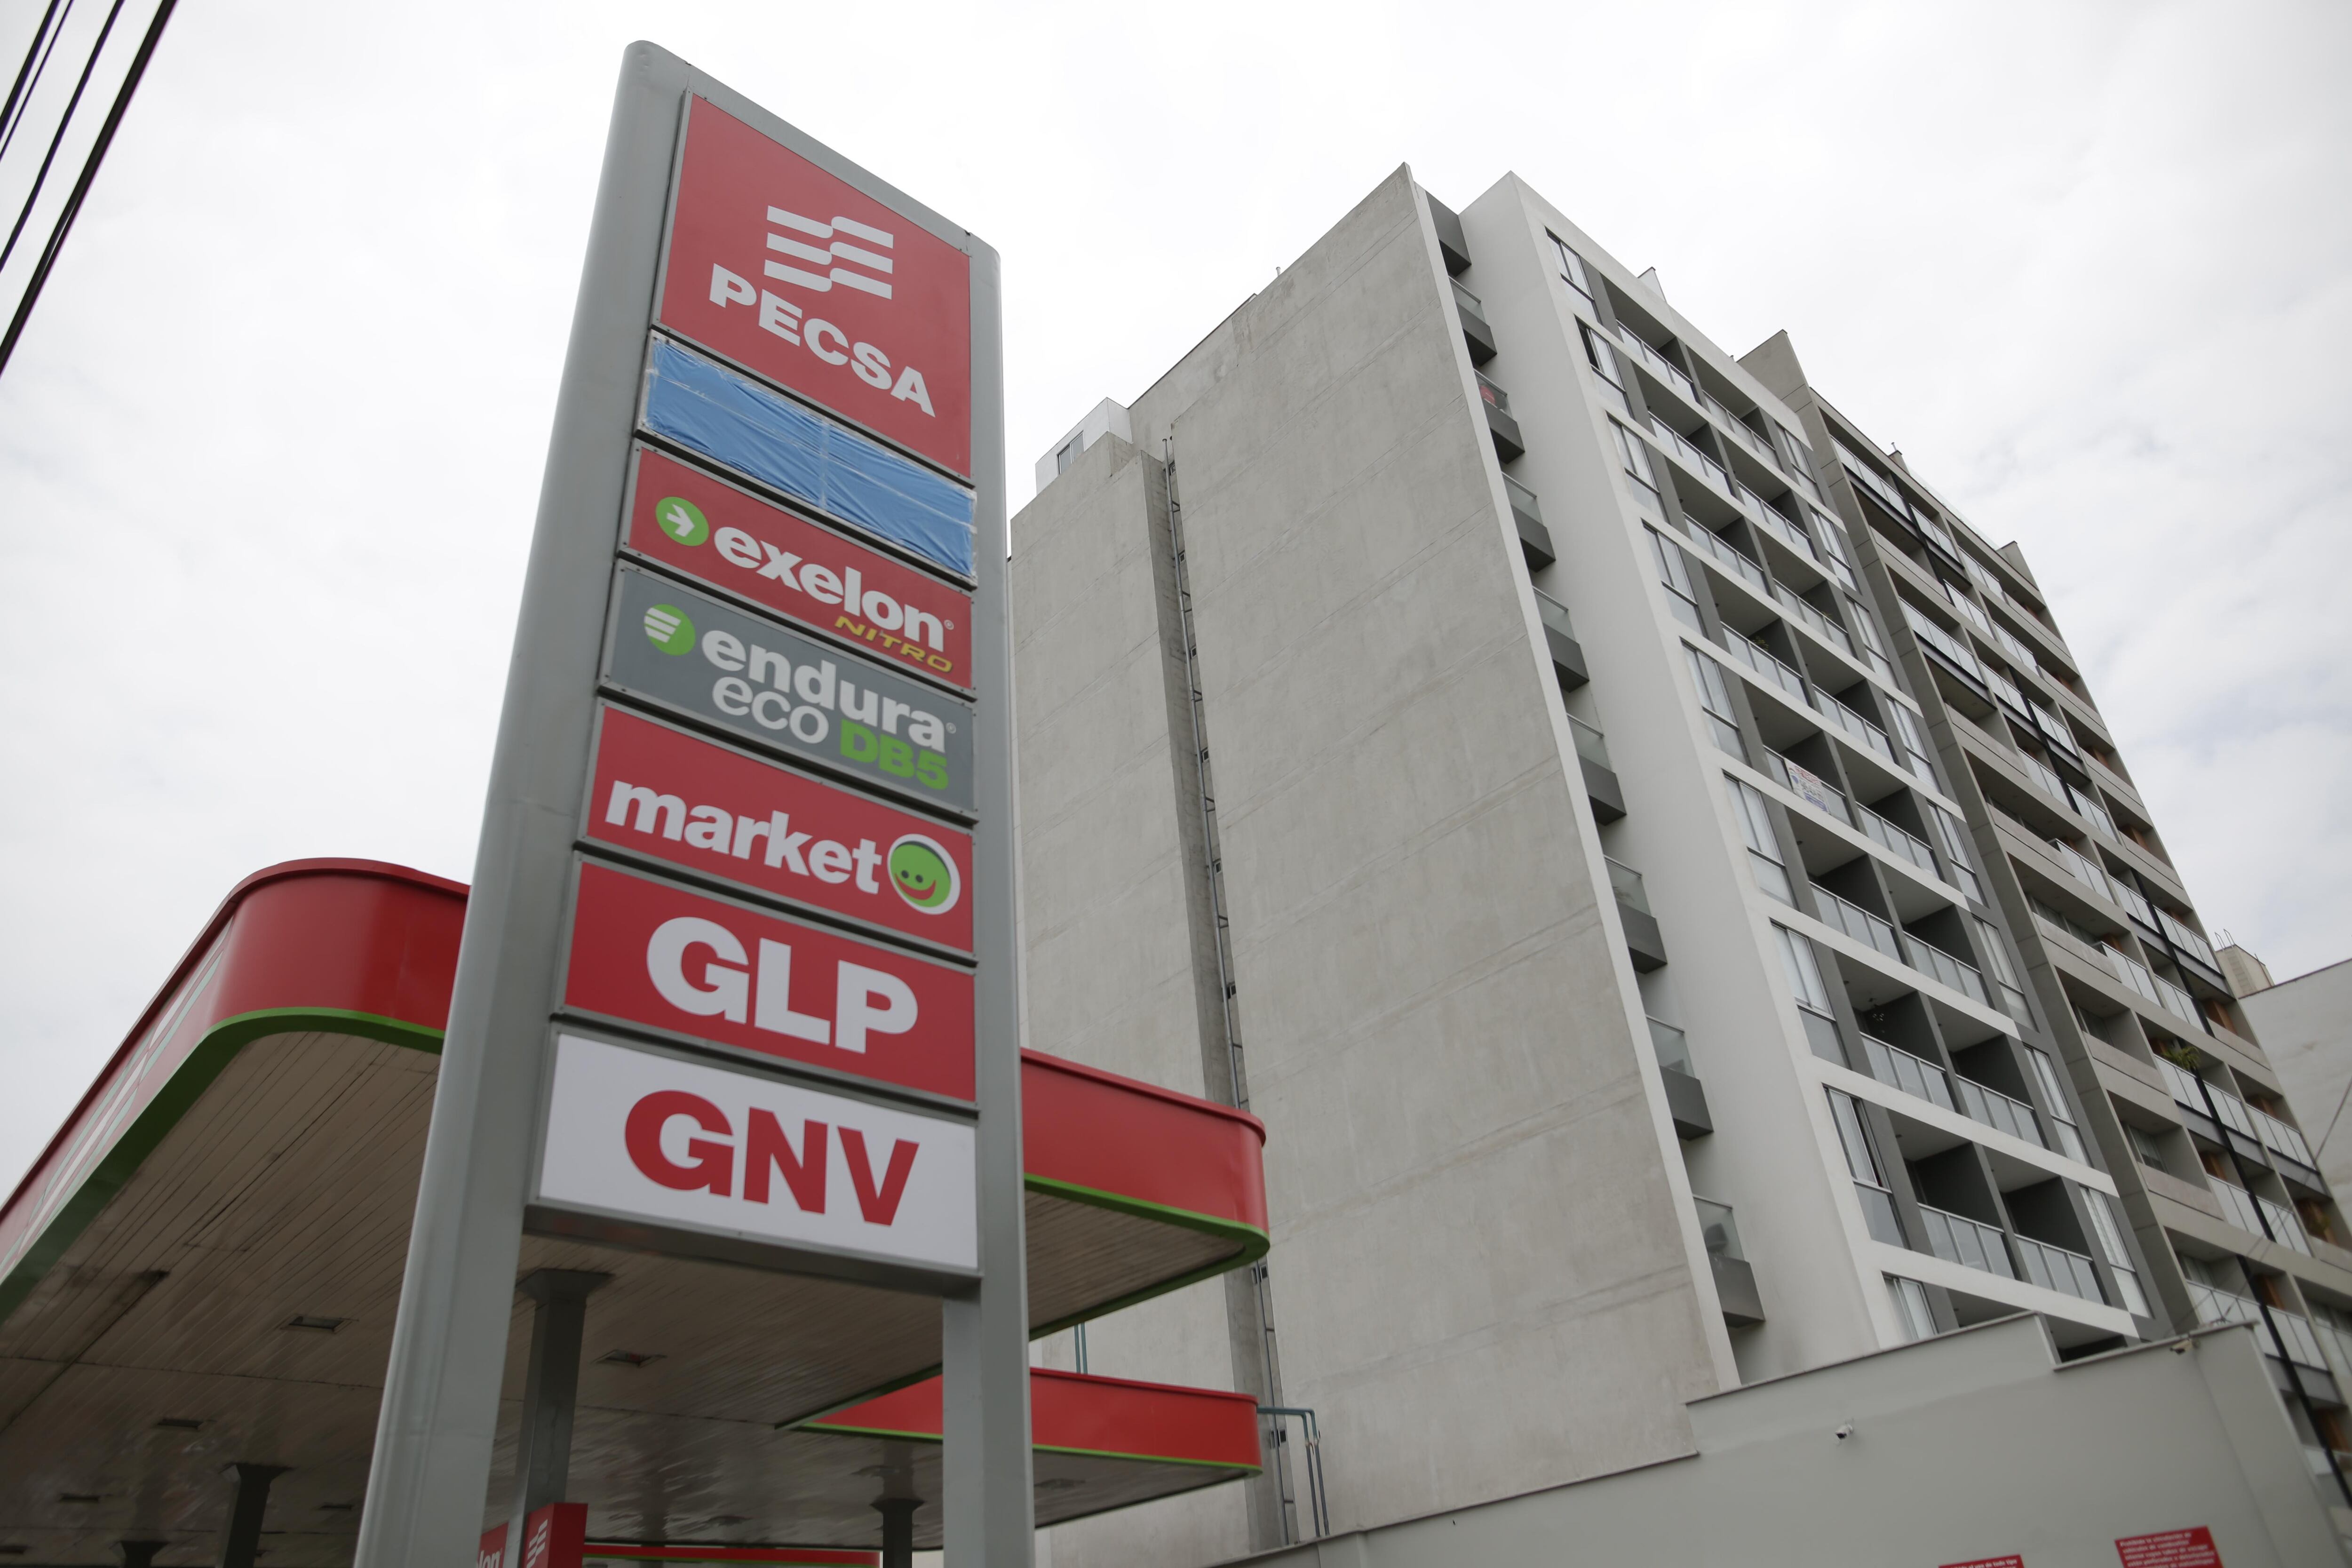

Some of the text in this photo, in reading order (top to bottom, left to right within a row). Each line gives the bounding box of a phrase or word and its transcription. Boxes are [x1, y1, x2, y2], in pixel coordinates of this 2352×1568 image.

[709, 263, 936, 417] PECSA
[714, 527, 944, 652] exelon
[834, 616, 953, 673] NITRO
[702, 630, 946, 753] endura
[713, 677, 949, 790] eco DB5
[605, 780, 882, 894] market
[646, 916, 918, 1054] GLP
[625, 1090, 920, 1226] GNV
